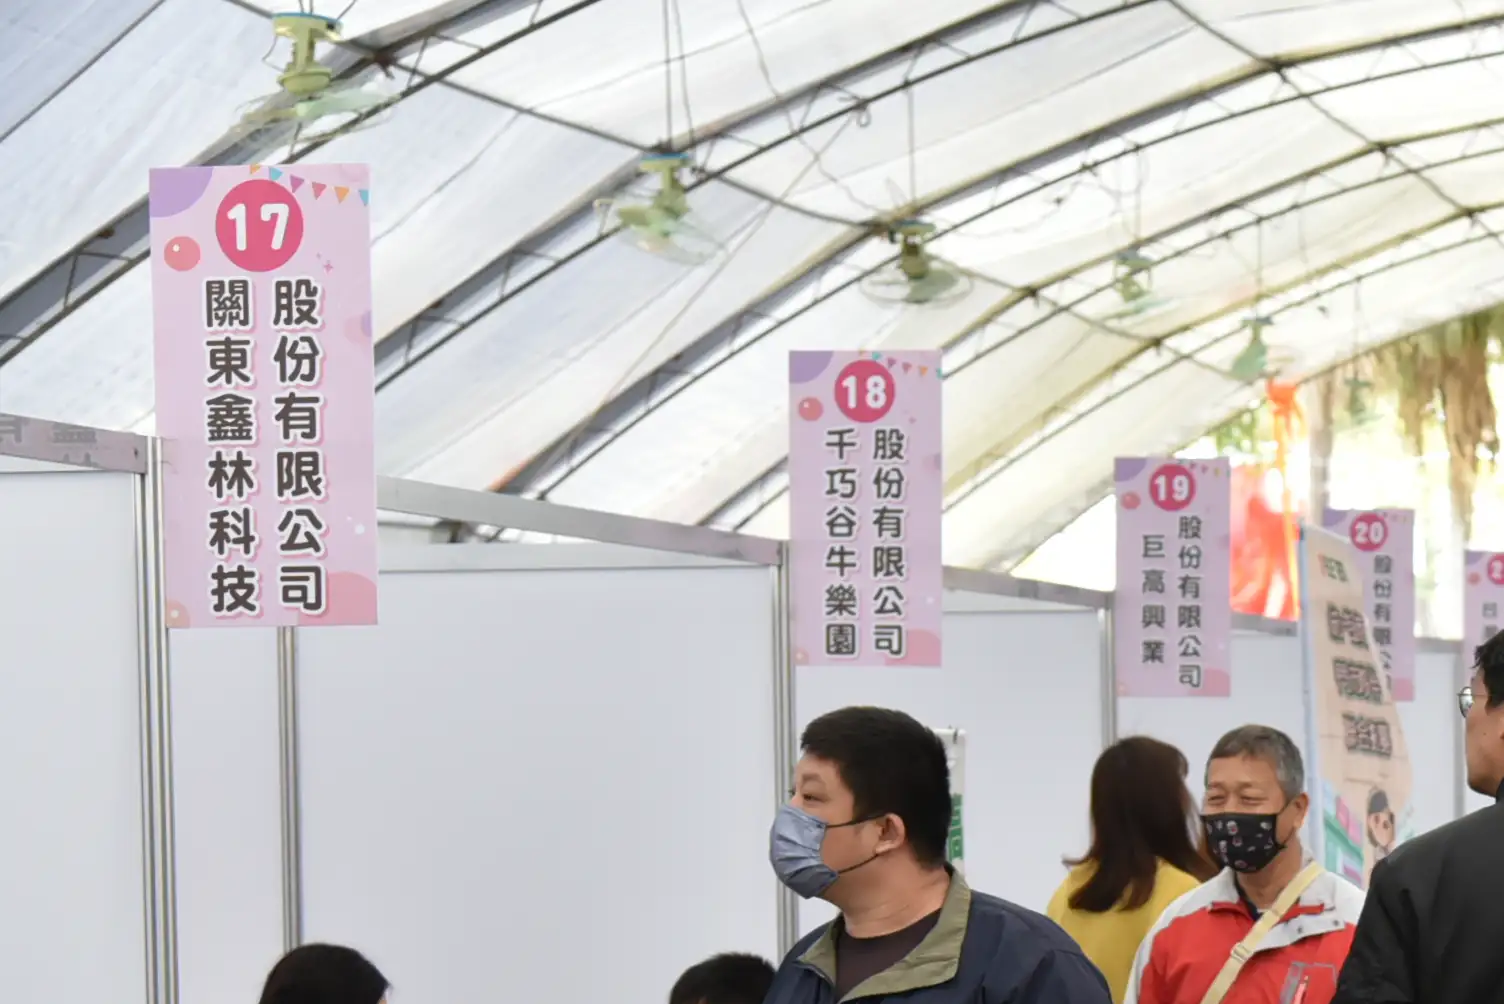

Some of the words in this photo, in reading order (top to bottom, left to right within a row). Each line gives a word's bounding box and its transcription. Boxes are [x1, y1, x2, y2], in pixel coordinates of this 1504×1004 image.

[226, 202, 290, 252] 17
[205, 279, 257, 614] 關東鑫林科技
[273, 279, 323, 613] 股份有限公司
[841, 374, 887, 410] 18
[825, 428, 857, 656] 千巧谷牛樂園
[872, 428, 905, 656] 股份有限公司
[1154, 474, 1190, 502] 19
[1354, 521, 1386, 543] 20
[1142, 534, 1166, 664] 巨高興業
[1178, 515, 1202, 688] 股份有限公司
